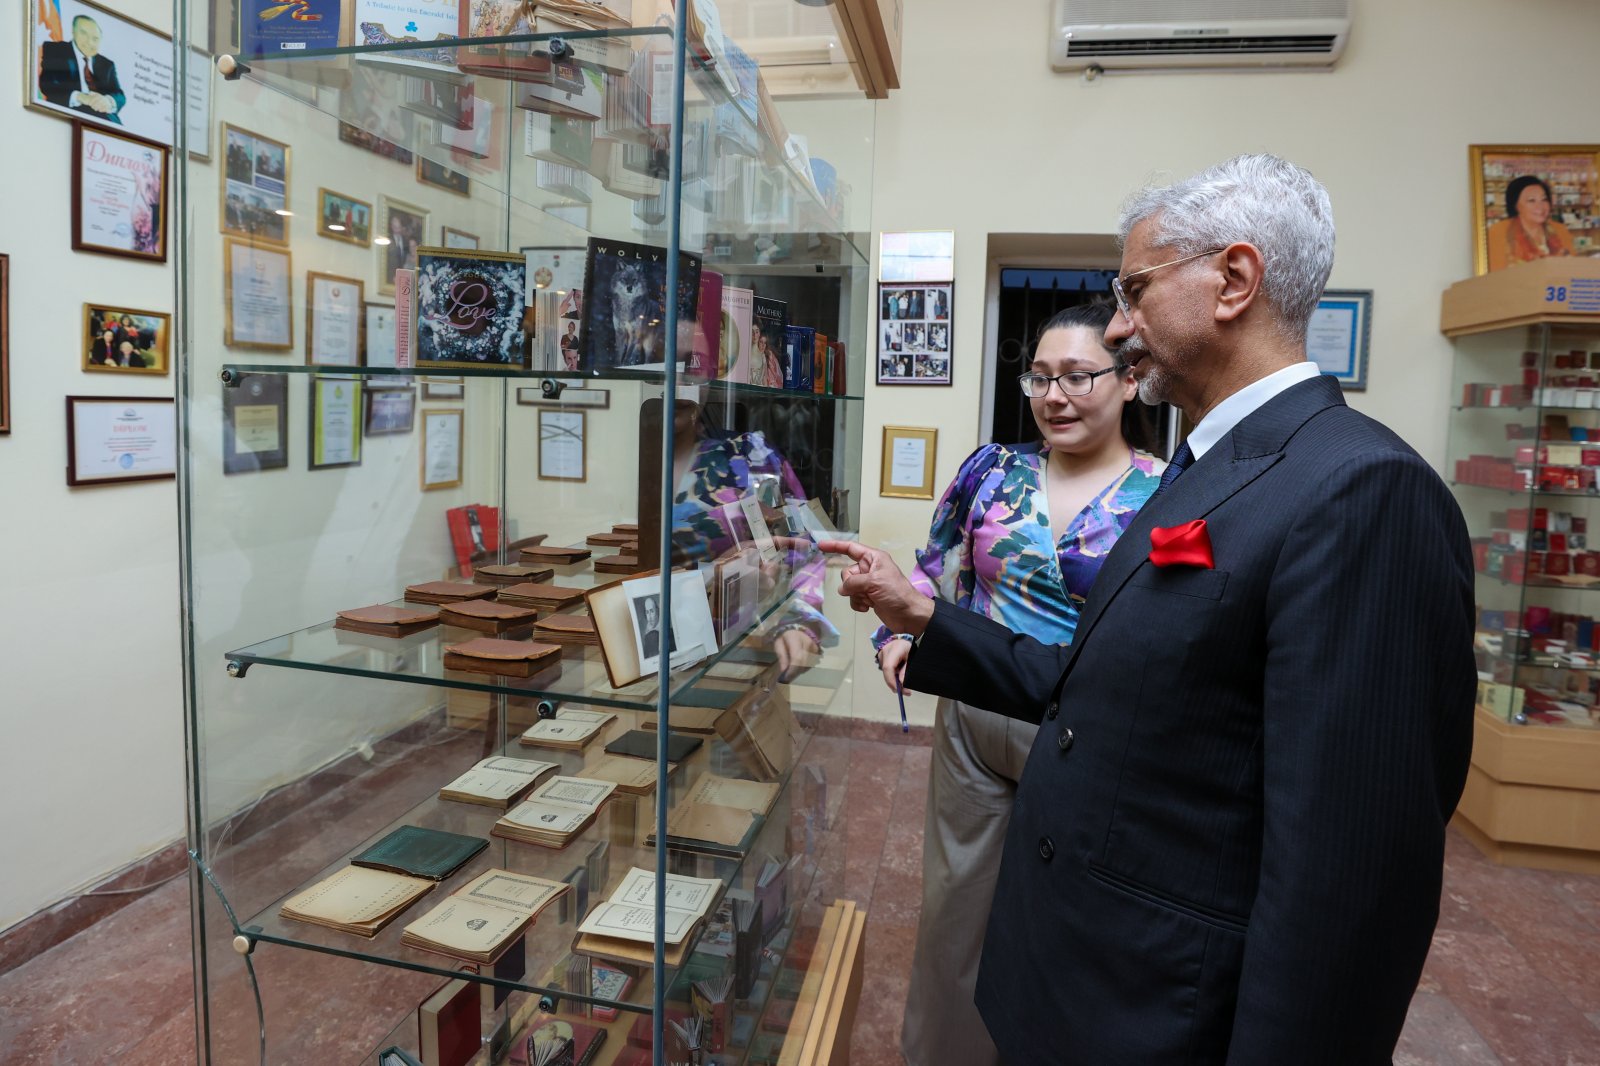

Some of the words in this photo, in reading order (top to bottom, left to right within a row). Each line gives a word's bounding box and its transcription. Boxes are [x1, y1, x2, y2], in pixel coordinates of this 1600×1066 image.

[397, 4, 405, 12] to
[407, 6, 417, 14] the
[419, 9, 444, 19] Emerald
[597, 246, 696, 268] WOLVS
[1545, 286, 1567, 302] 38
[424, 281, 497, 330] Love
